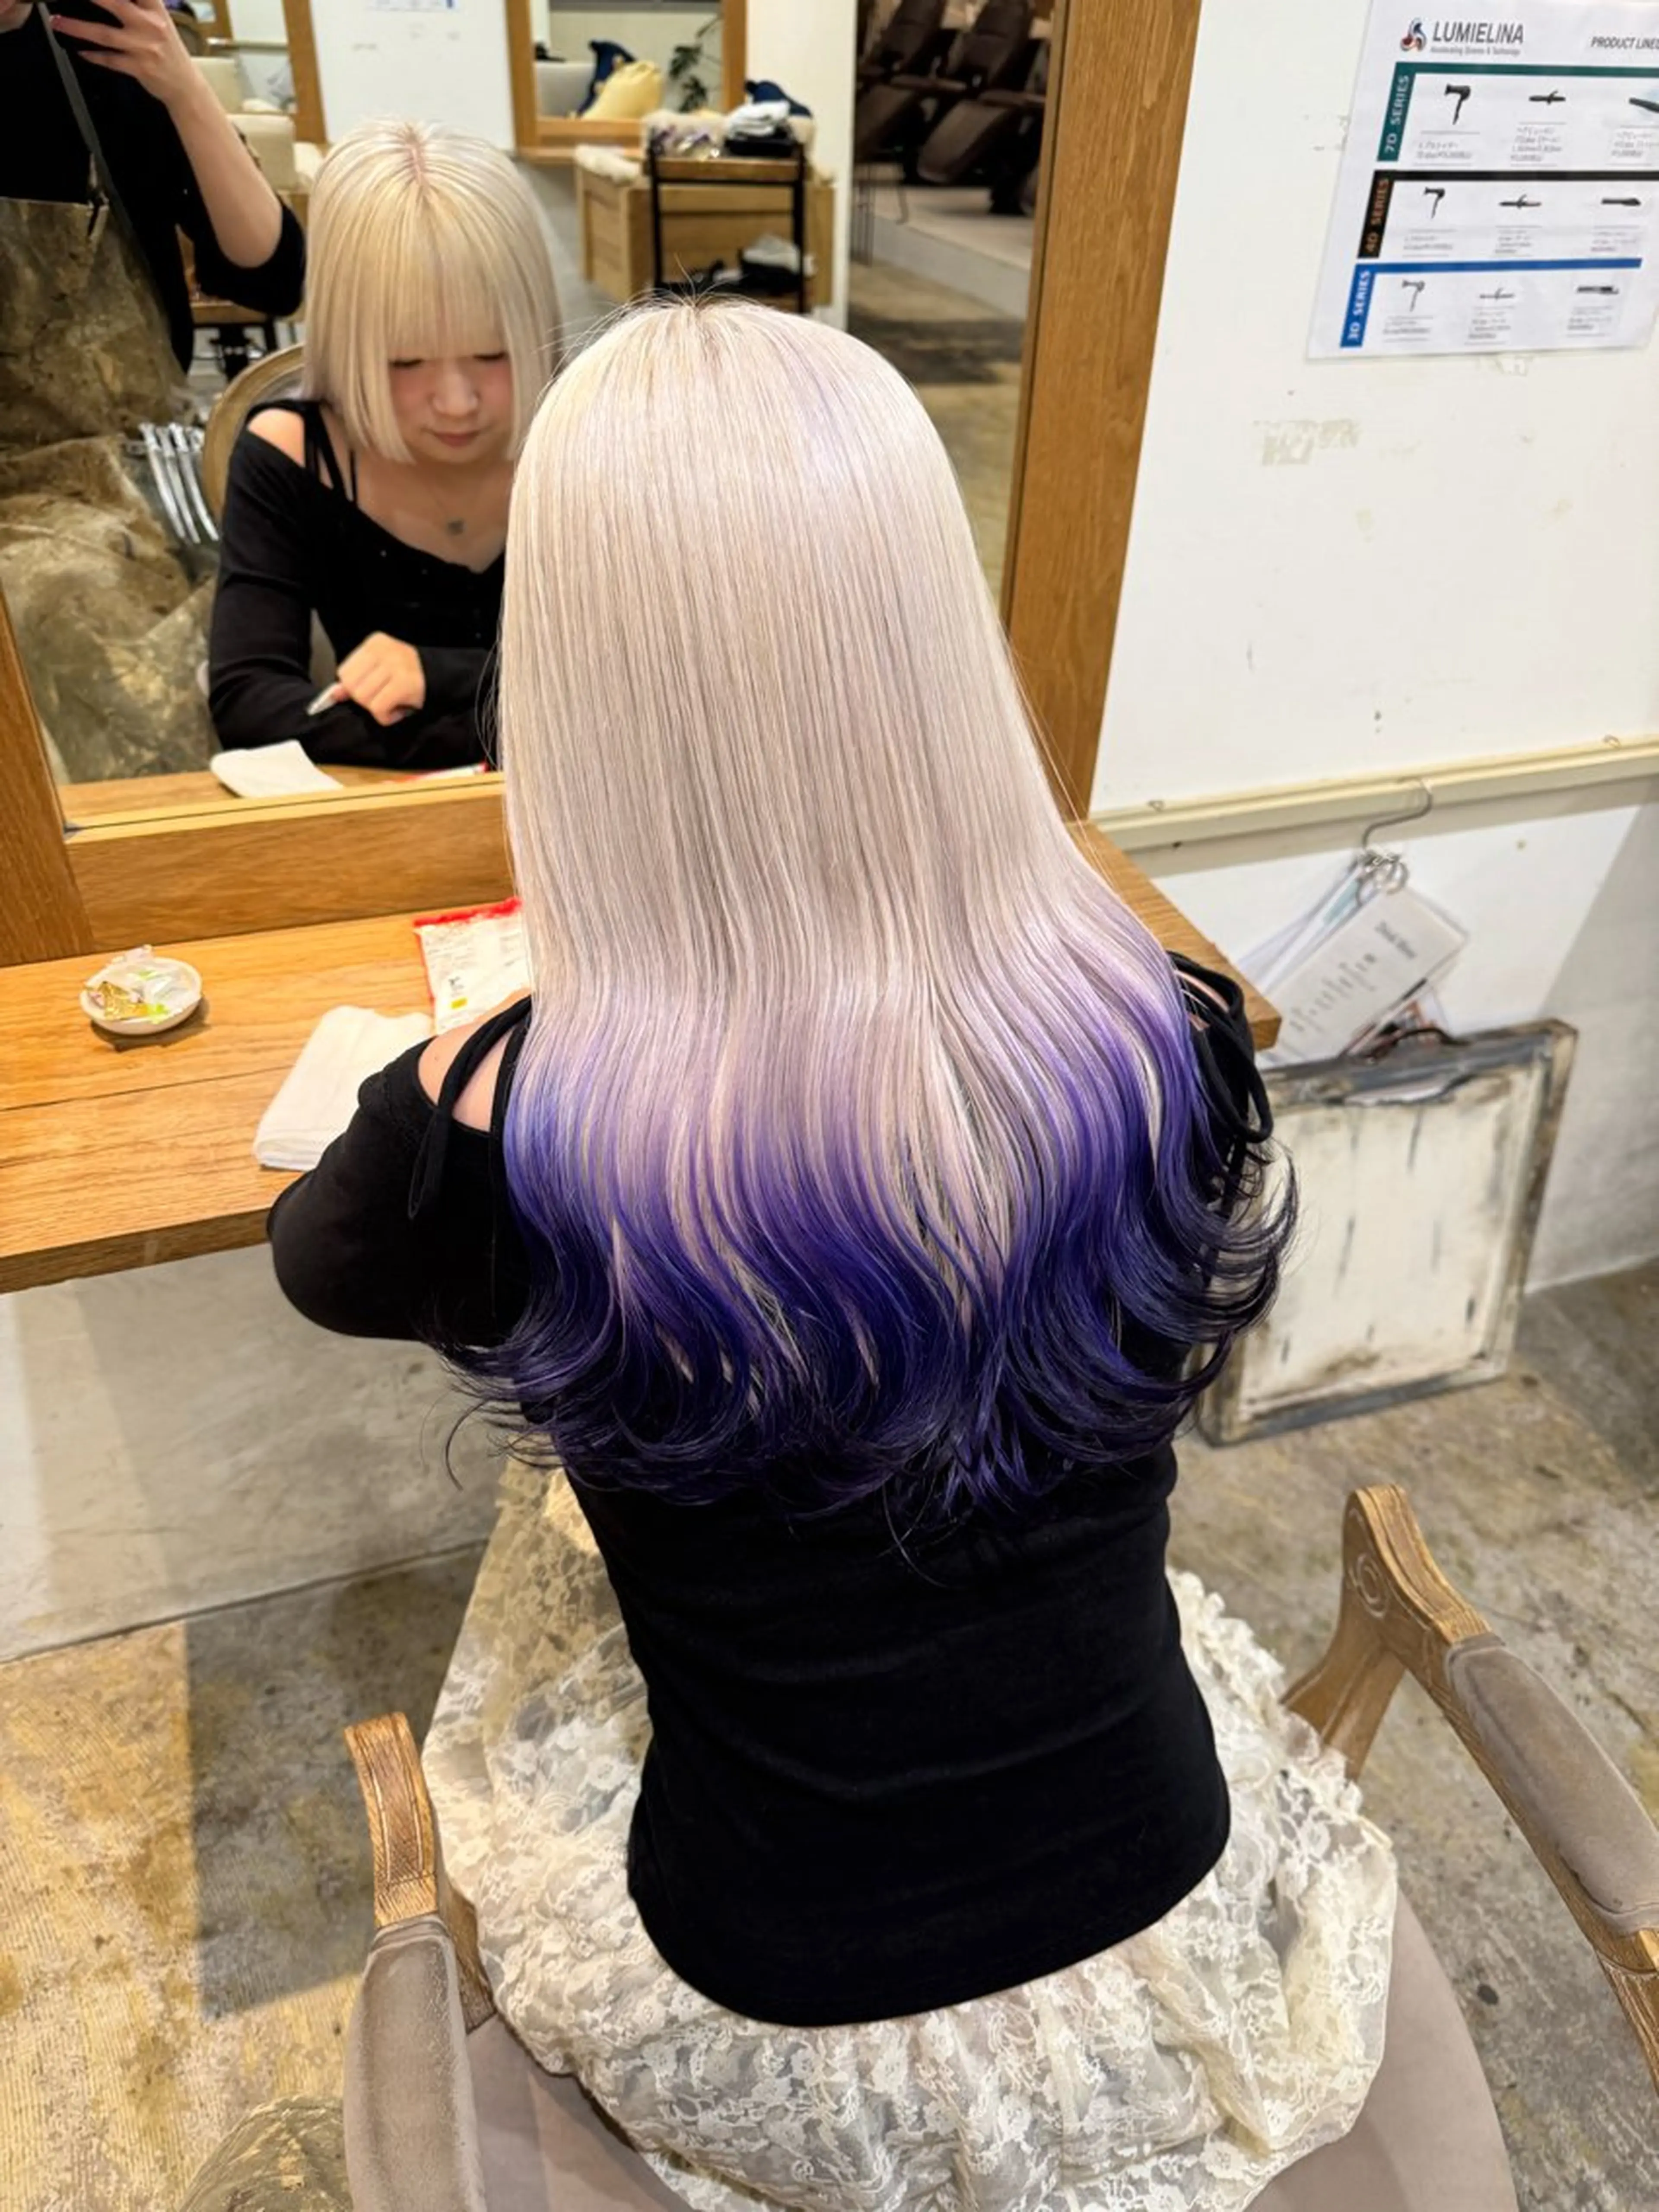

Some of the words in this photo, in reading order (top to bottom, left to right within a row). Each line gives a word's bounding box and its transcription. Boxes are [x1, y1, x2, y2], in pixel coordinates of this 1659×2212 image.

[1432, 21, 1524, 44] LUMIELINA
[1590, 36, 1636, 50] PRODUCT
[1390, 75, 1409, 126] SERIES
[1384, 132, 1398, 154] 7D
[1352, 270, 1371, 316] SERIES
[1347, 321, 1361, 343] 3D
